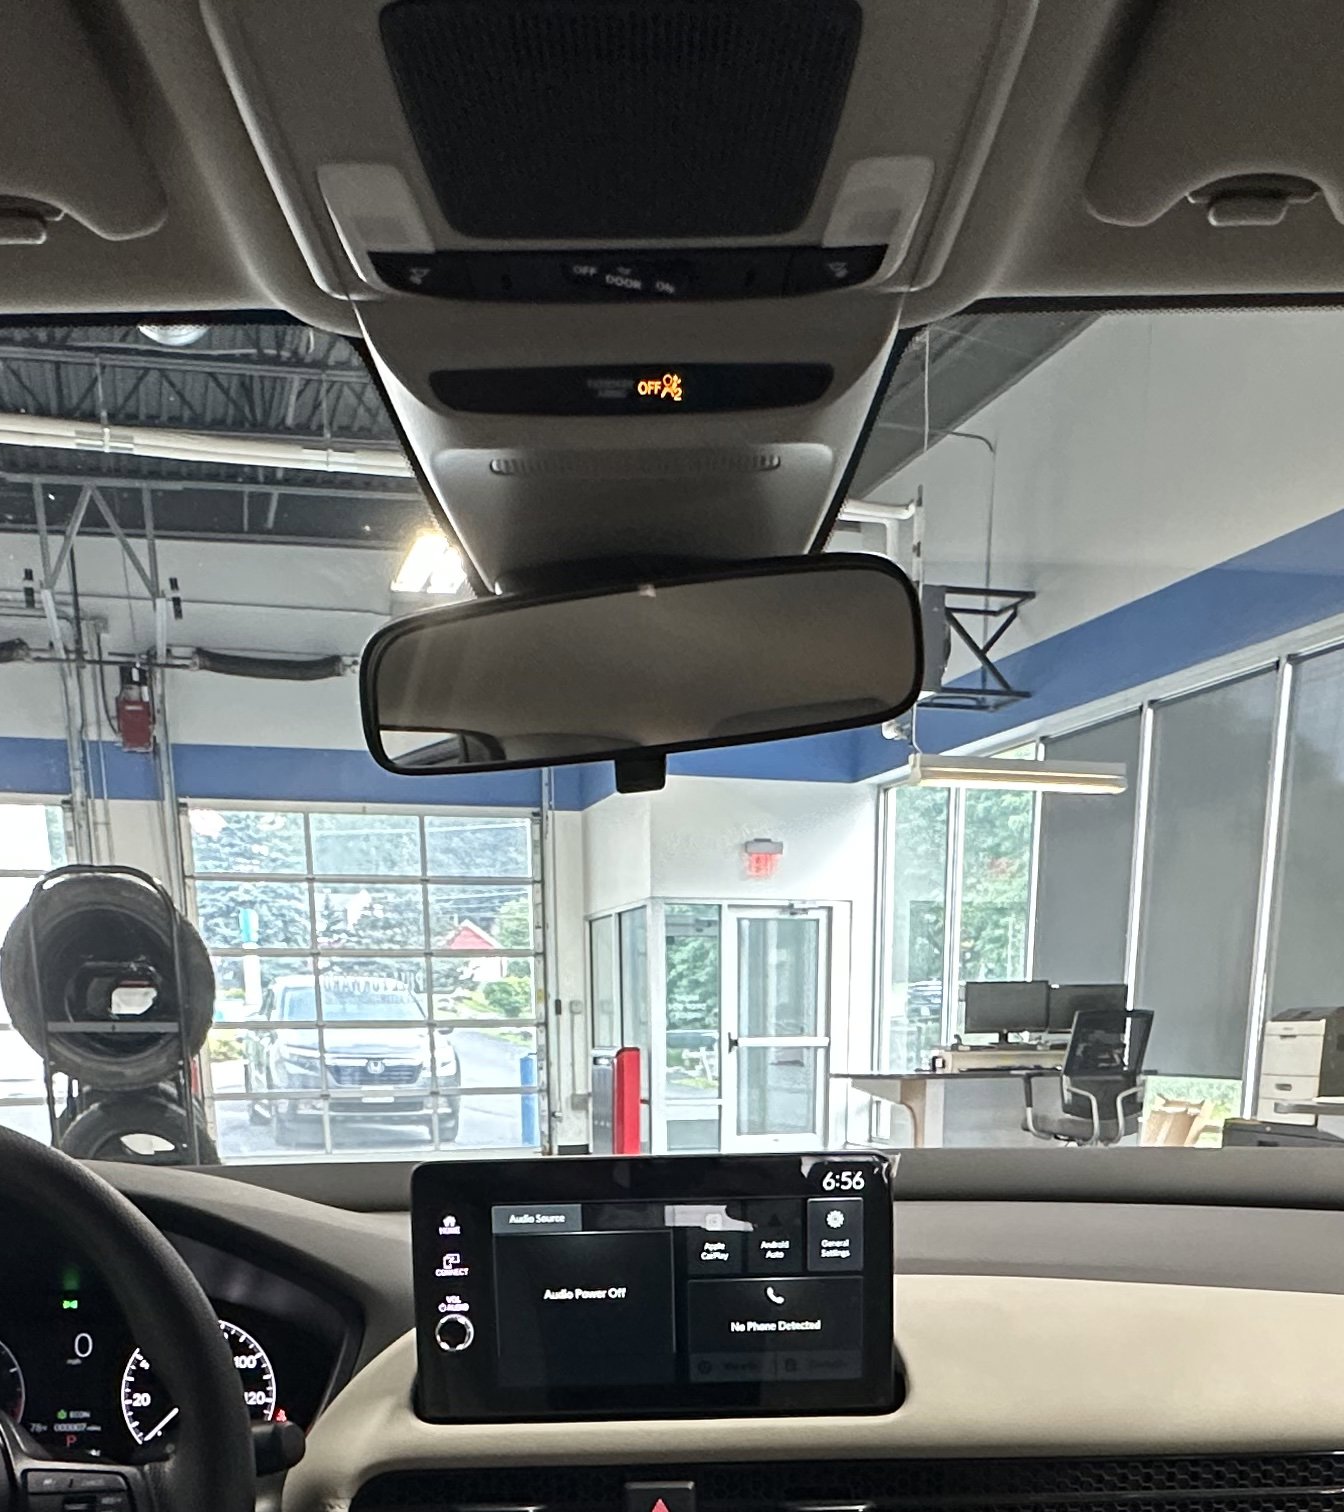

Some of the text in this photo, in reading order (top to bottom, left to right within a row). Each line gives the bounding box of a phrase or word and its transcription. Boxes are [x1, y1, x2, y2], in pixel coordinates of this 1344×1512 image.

[605, 273, 642, 290] DOOR
[637, 380, 662, 396] OFF
[822, 1170, 866, 1192] 6:56
[509, 1212, 566, 1224] Audio Source
[543, 1285, 627, 1300] Audio Power Off
[730, 1320, 822, 1332] No Phone Detected
[74, 1332, 93, 1358] 0
[233, 1355, 257, 1369] 100
[132, 1392, 152, 1407] 20
[66, 1434, 78, 1448] P
